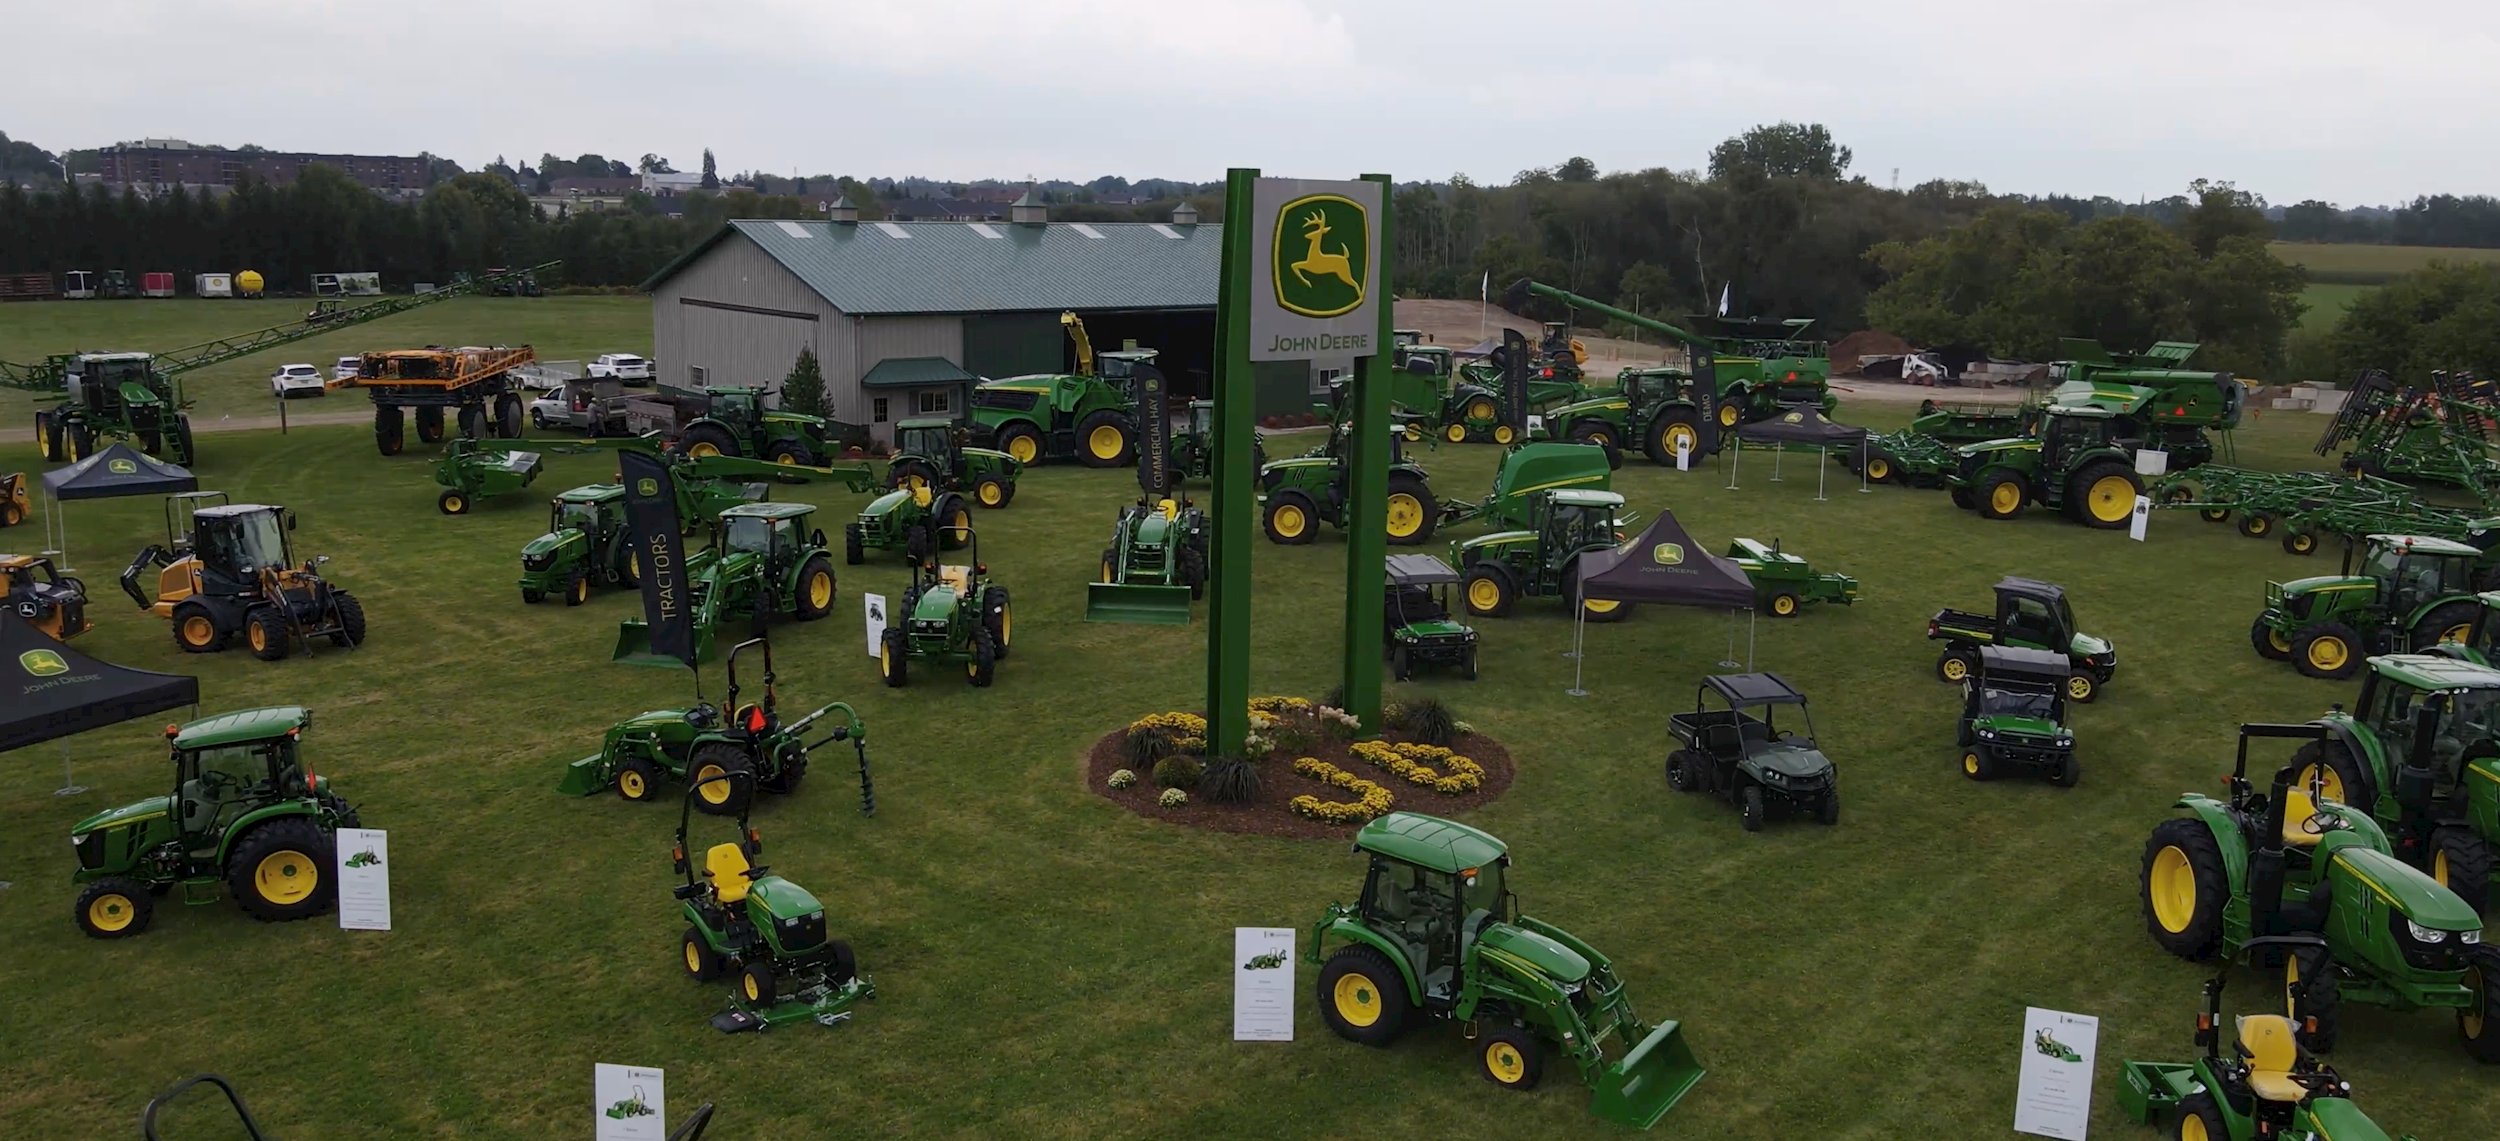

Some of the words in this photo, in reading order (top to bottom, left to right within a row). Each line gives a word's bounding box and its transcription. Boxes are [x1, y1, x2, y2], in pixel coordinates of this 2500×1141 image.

[1268, 335, 1317, 352] JOHN
[1320, 333, 1368, 350] DEERE
[1148, 399, 1160, 418] HAY
[1702, 393, 1713, 422] DEMO
[1149, 421, 1163, 488] COMMERCIAL
[650, 533, 677, 621] TRACTORS
[1667, 567, 1699, 575] DEERE
[23, 680, 60, 695] JOHN
[60, 673, 102, 685] DEERE
